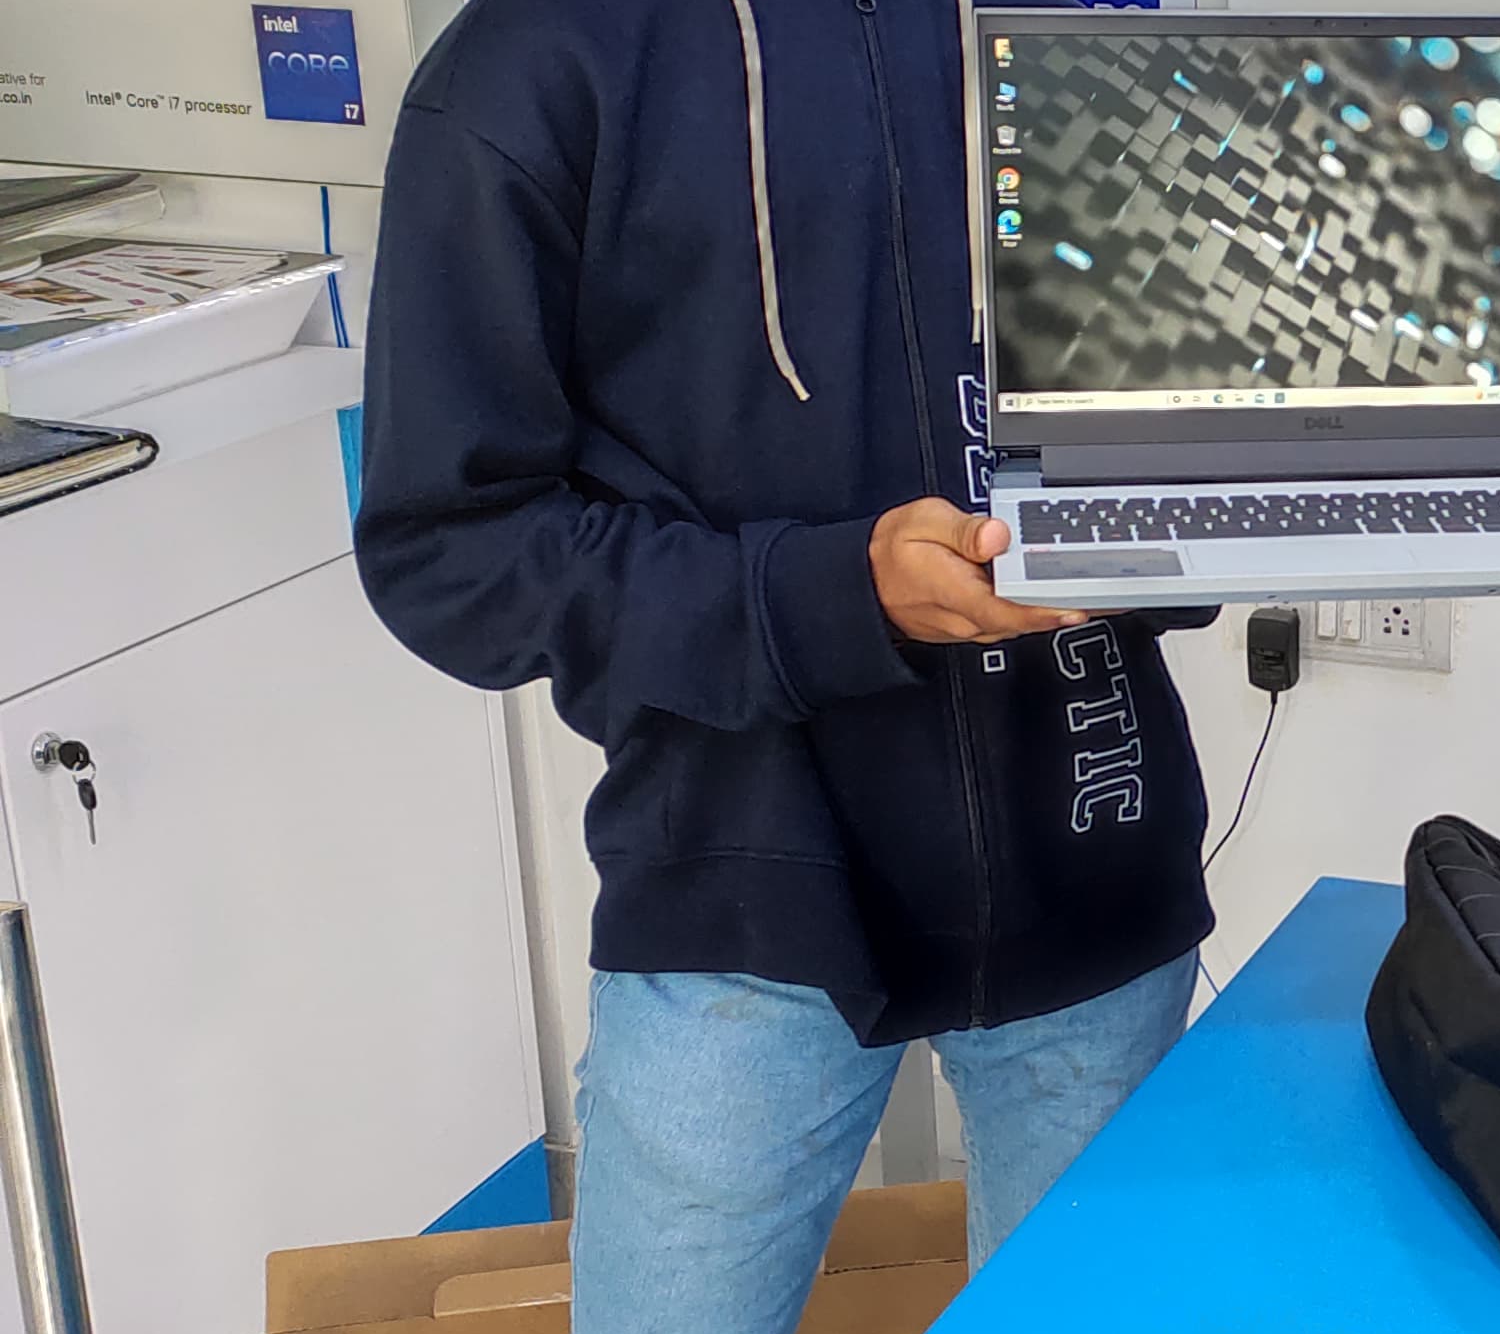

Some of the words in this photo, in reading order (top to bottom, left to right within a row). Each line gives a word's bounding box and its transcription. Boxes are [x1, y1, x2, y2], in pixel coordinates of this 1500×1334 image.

[263, 15, 298, 34] intel
[29, 72, 47, 86] for
[168, 96, 181, 111] i7
[185, 98, 253, 116] processor
[344, 103, 360, 120] i7
